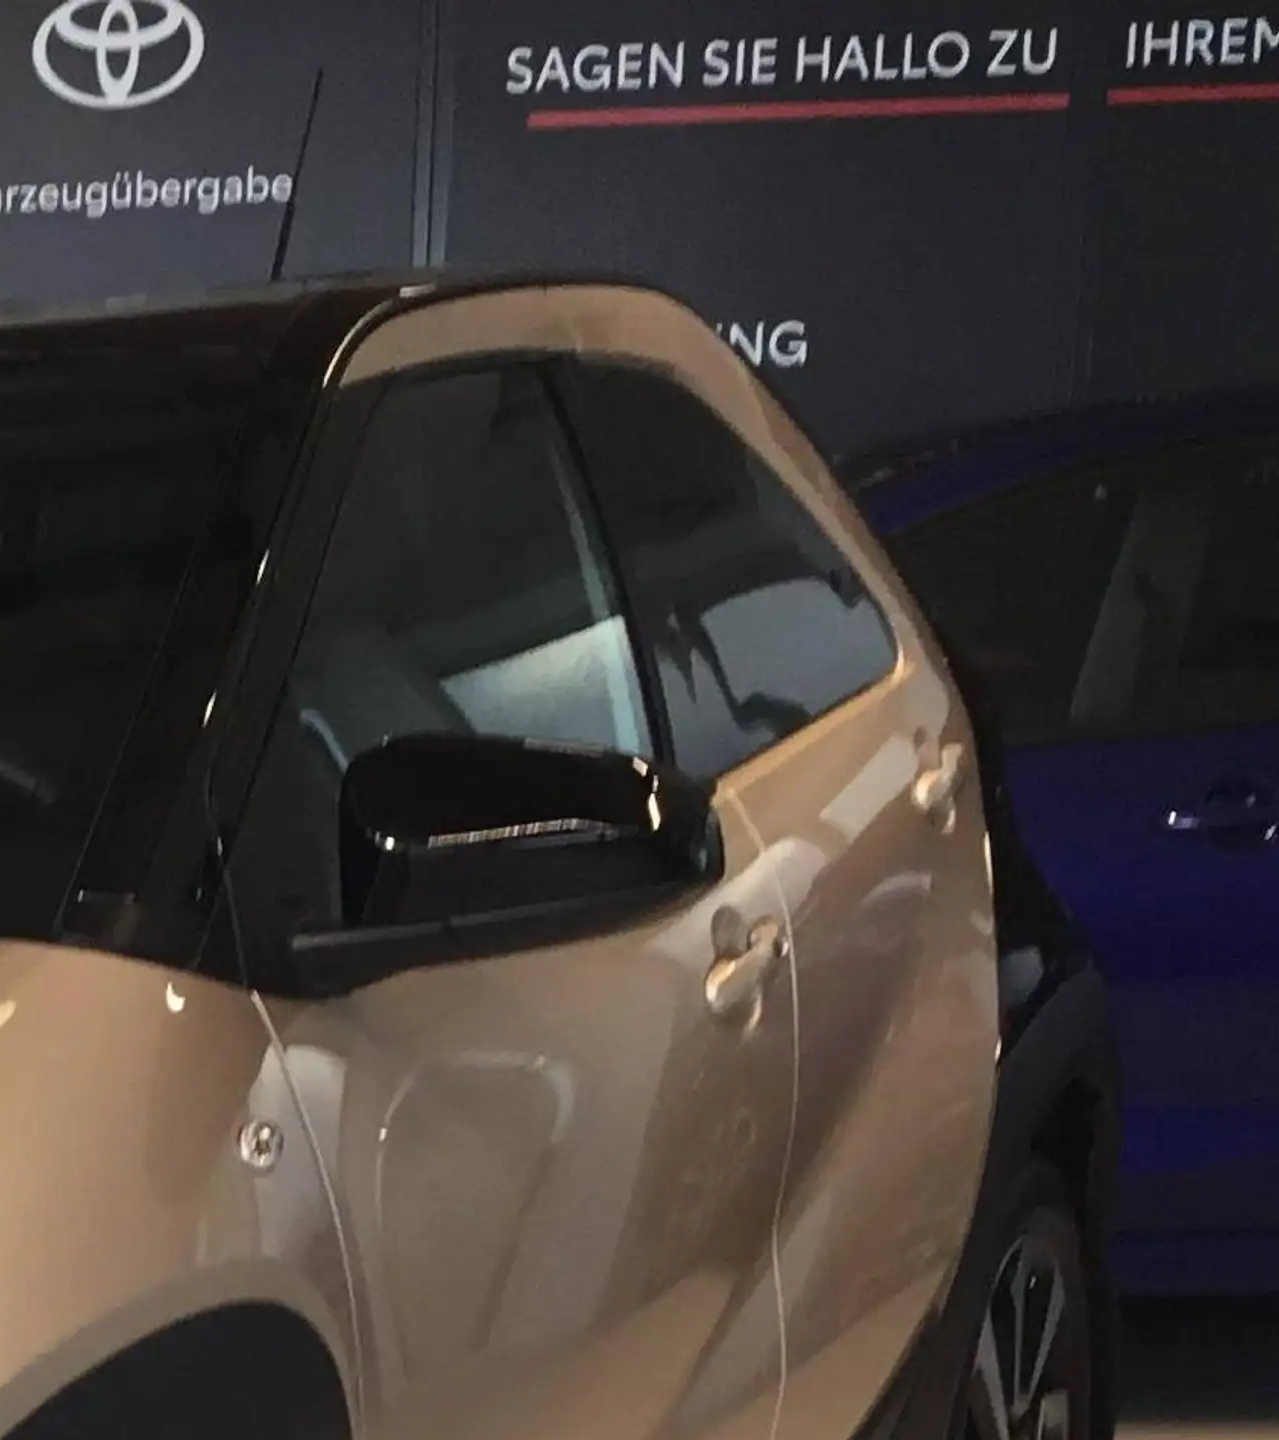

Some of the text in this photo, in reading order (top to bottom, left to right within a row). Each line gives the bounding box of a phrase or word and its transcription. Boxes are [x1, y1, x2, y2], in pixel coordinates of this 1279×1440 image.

[506, 42, 685, 95] SAGEN
[702, 37, 778, 88] SIE
[794, 31, 970, 83] HALLO
[986, 28, 1058, 77] ZU
